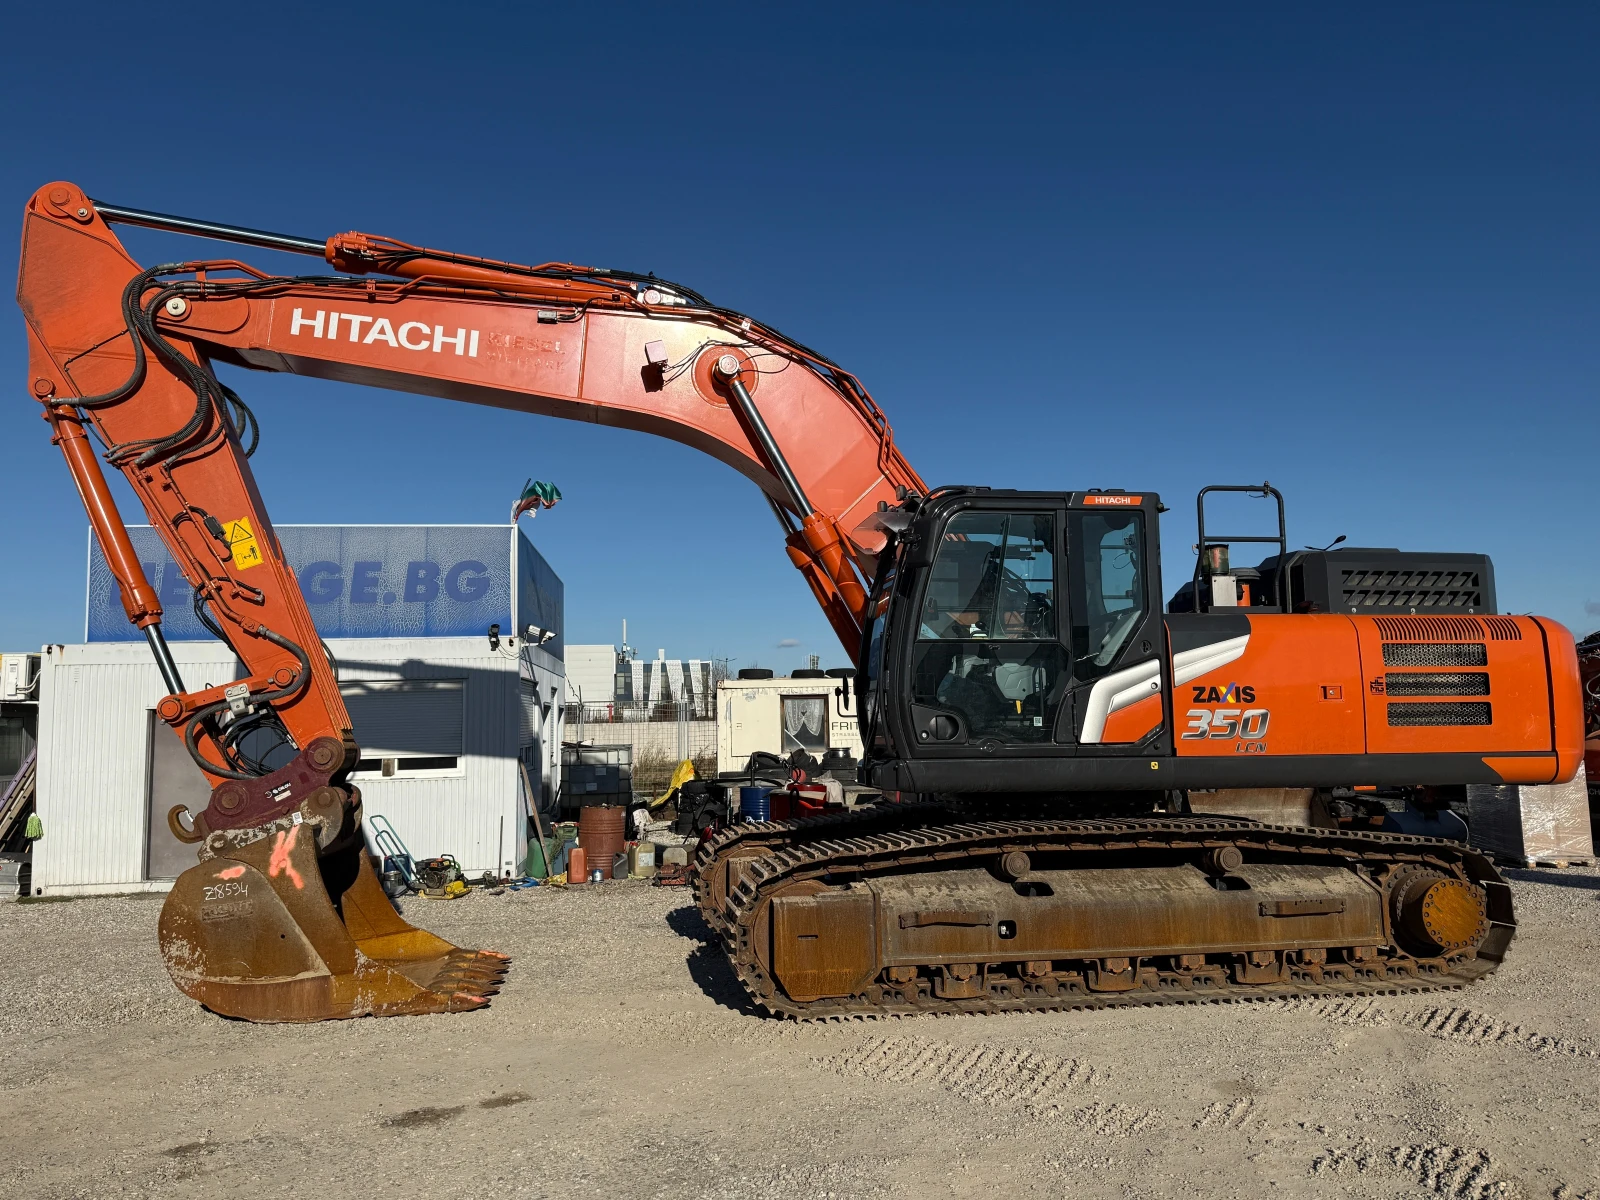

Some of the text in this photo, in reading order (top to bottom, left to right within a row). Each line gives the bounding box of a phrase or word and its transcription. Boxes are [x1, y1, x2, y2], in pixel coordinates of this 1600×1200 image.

[290, 308, 480, 357] HITACHI
[1095, 496, 1131, 504] HITACHI
[109, 561, 491, 604] EGE.BG
[1192, 682, 1256, 704] ZAXIS
[831, 721, 859, 731] FRIT
[1181, 708, 1270, 740] 350
[1235, 741, 1267, 754] LCN
